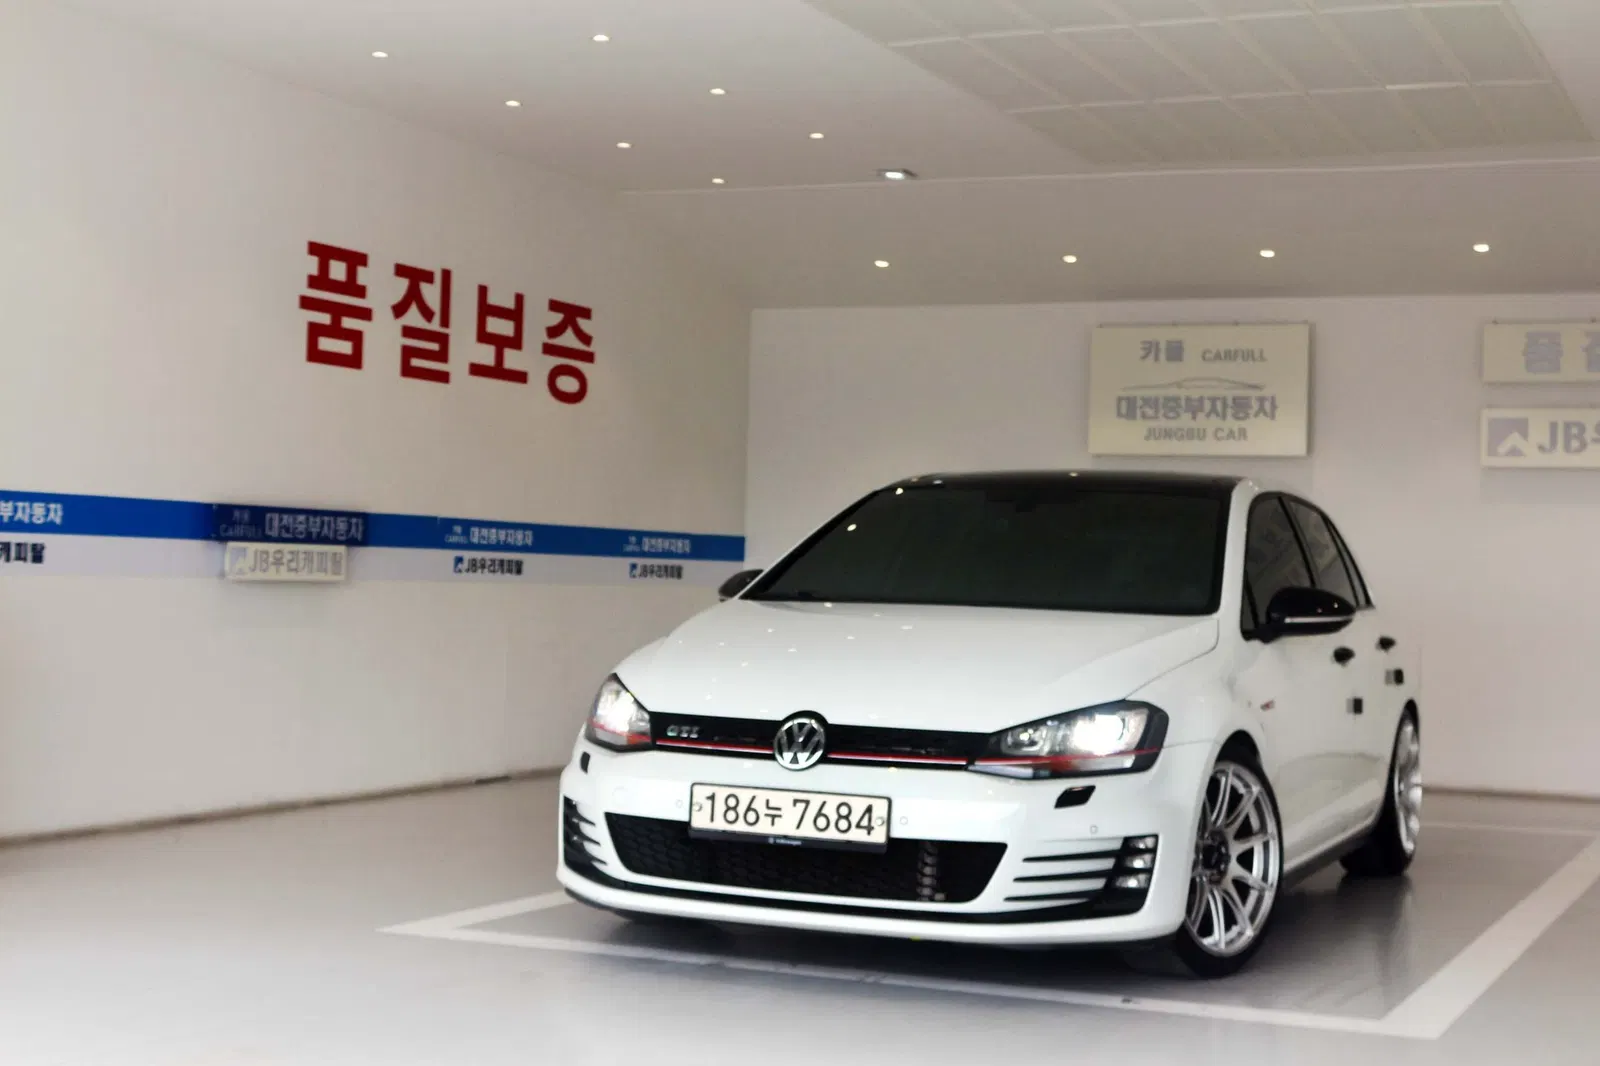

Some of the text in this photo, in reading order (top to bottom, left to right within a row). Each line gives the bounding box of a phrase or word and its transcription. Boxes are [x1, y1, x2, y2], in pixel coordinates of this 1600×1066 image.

[299, 241, 595, 404] 품질보증
[1214, 427, 1249, 442] CAR
[666, 725, 699, 739] GTI
[705, 792, 875, 836] 186누 7684
